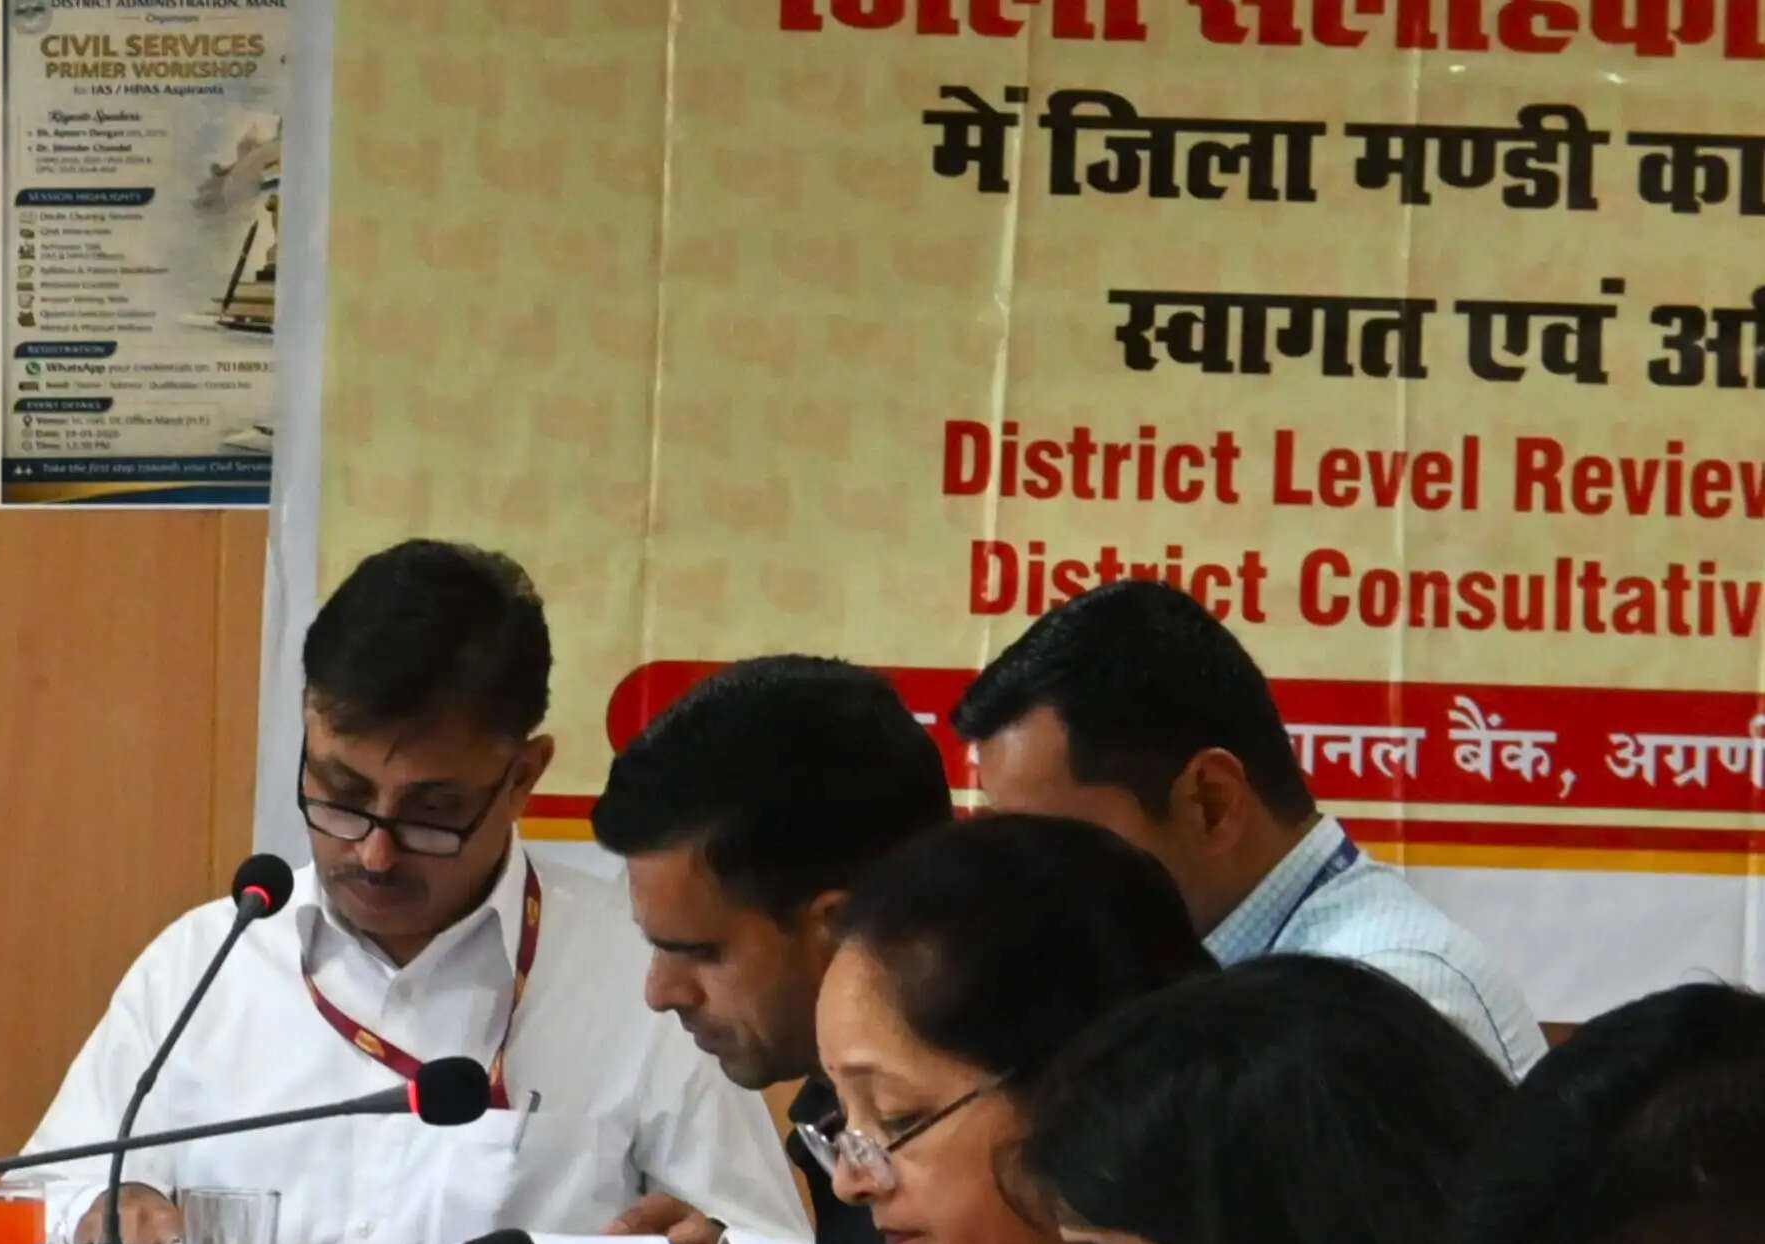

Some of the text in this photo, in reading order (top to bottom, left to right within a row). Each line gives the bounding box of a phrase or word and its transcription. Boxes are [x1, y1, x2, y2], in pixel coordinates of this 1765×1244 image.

[40, 33, 265, 58] CIVIL SERVICES
[45, 61, 258, 79] PRIMER WORKSHOP
[91, 85, 113, 95] IAS
[124, 85, 160, 95] HPAS
[163, 85, 224, 98] Aspirants
[922, 85, 1030, 194] में
[1038, 88, 1326, 202] जिला
[1344, 103, 1610, 211] मण्डी
[46, 362, 106, 375] WhatsApp
[1107, 289, 1437, 379] स्वागत
[1454, 277, 1626, 385] एवं
[942, 419, 1242, 505] District
[1273, 429, 1480, 511] Level
[1298, 547, 1763, 638] Consultativ
[1447, 695, 1577, 798] बैंक,
